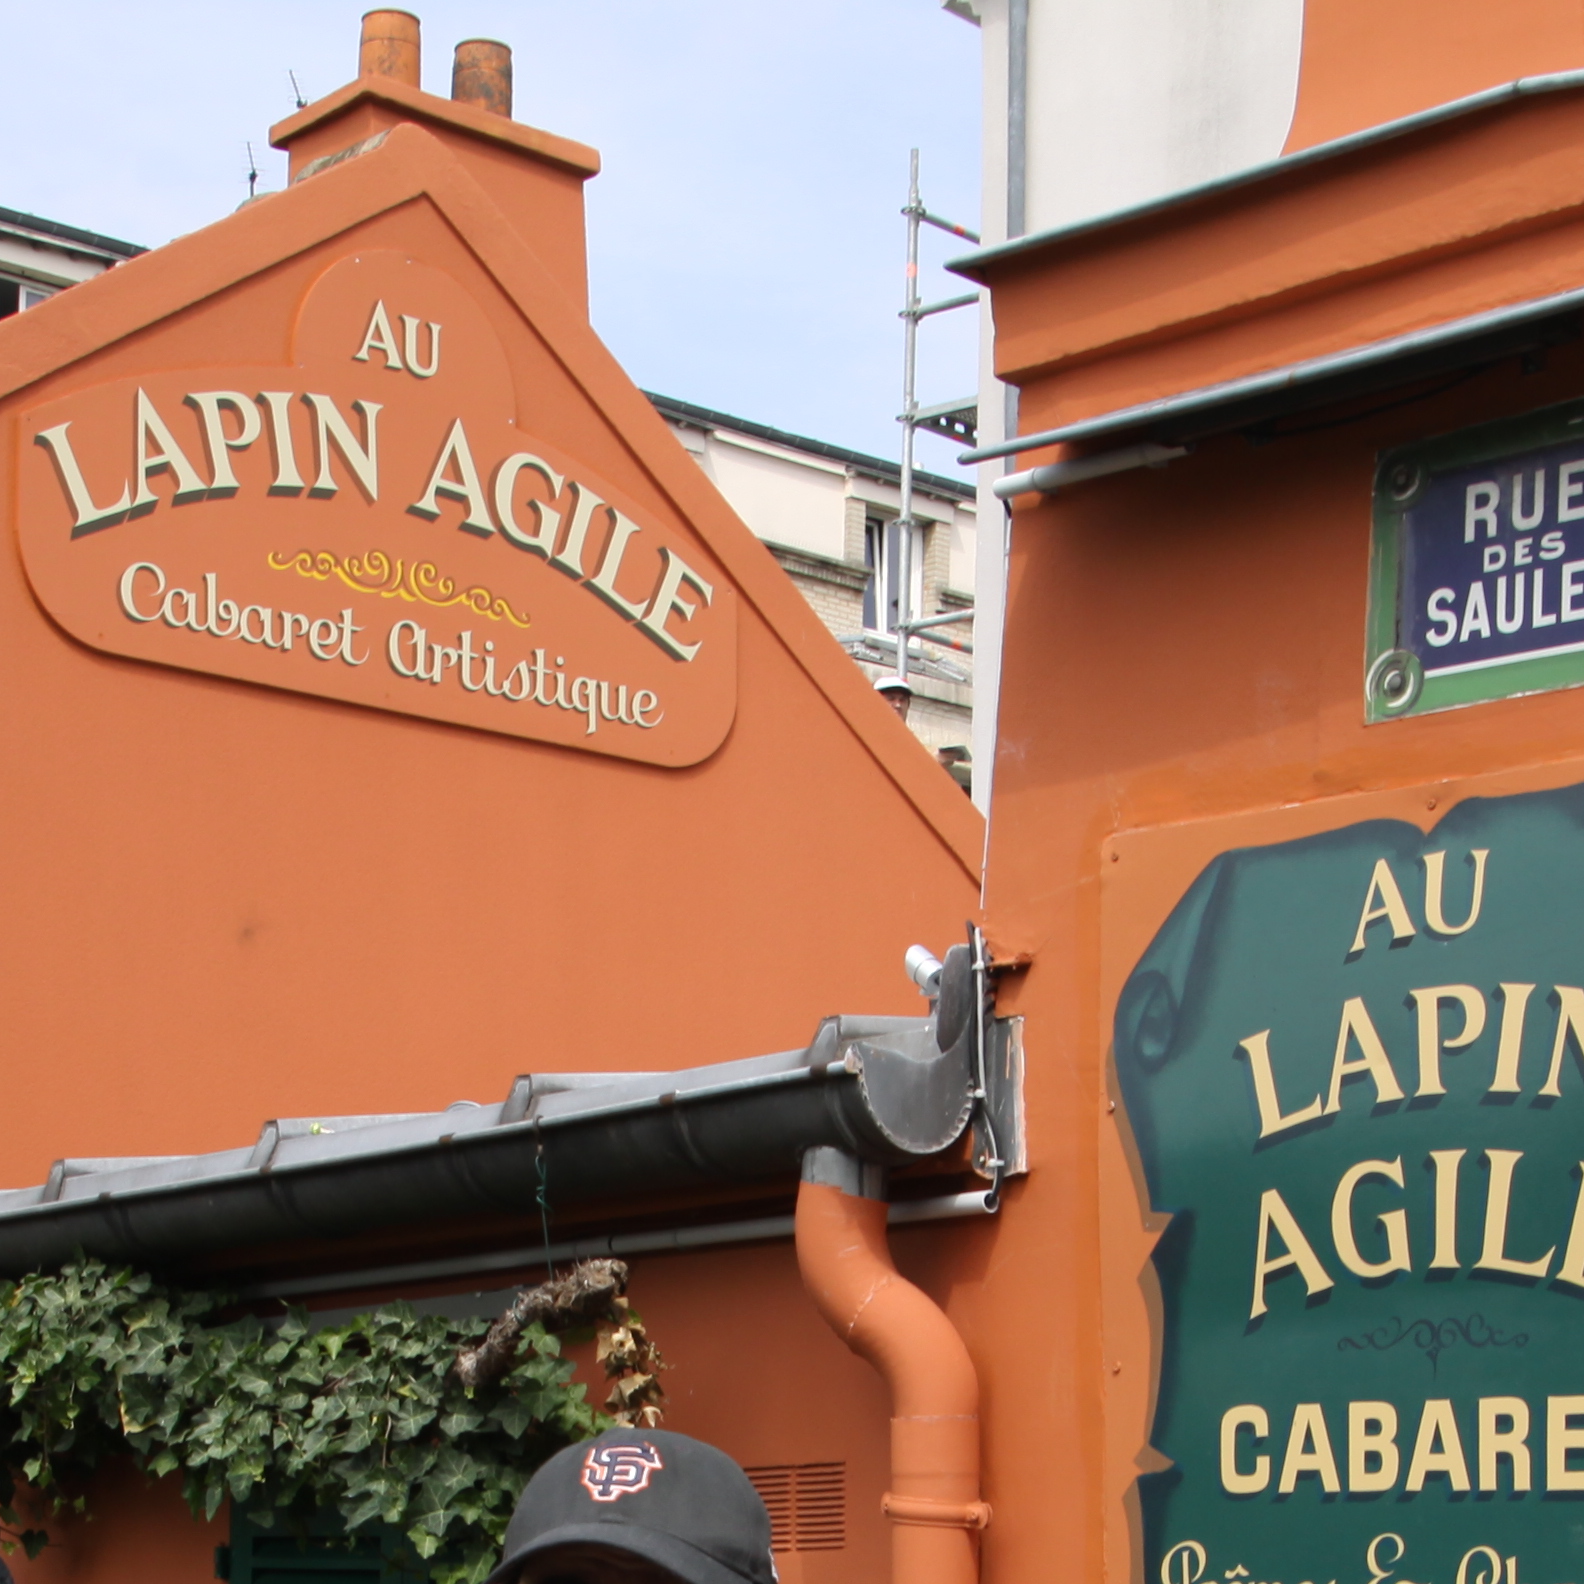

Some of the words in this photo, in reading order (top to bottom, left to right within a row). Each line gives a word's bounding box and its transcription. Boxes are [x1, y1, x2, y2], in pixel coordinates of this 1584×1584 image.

[354, 299, 442, 377] AU
[35, 386, 384, 530] LAPIN
[415, 417, 714, 662] AGILE
[1483, 530, 1566, 574] DES
[119, 561, 370, 666] Cabaret
[1349, 848, 1490, 954] AU
